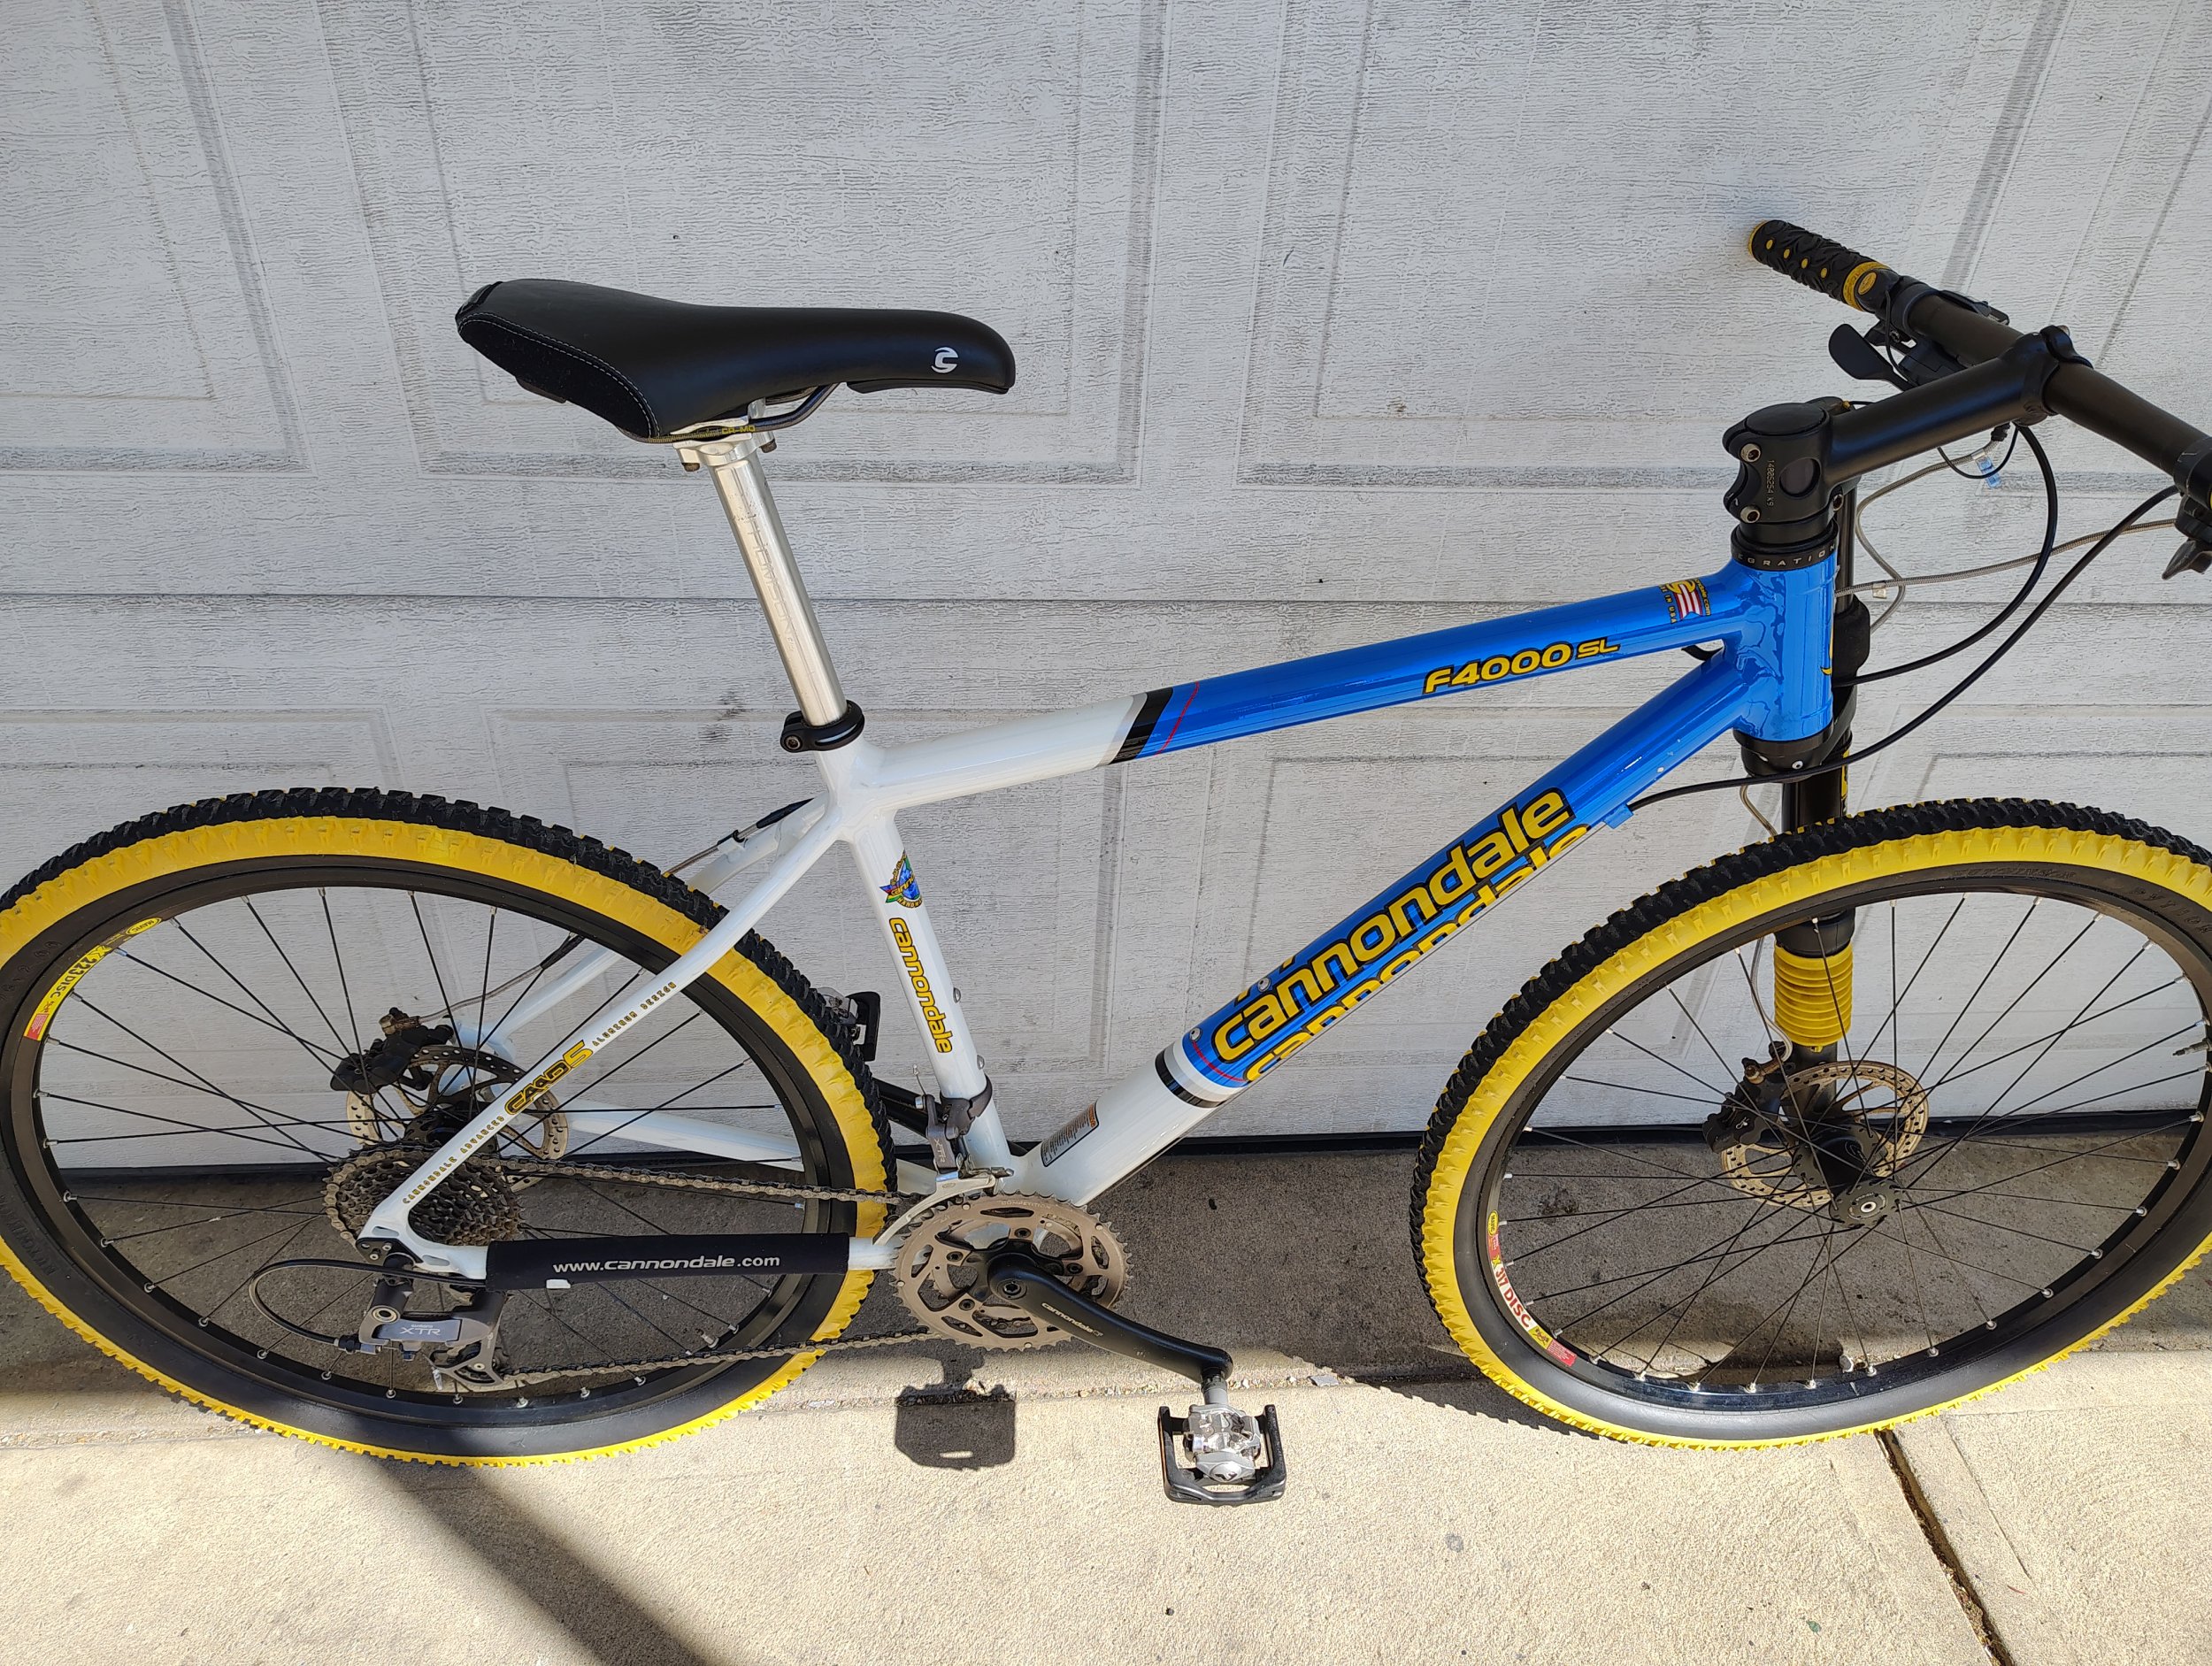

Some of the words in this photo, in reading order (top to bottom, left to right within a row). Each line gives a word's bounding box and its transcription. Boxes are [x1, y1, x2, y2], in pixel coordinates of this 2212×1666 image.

[1423, 641, 1574, 695] F4000
[1575, 636, 1621, 660] SL
[1211, 787, 1577, 1063] cannondale
[50, 976, 77, 999] DISC
[889, 917, 953, 1054] cannondale
[402, 1155, 457, 1204] CANNONDALE
[1041, 1302, 1094, 1333] cannondale
[1495, 1267, 1510, 1287] 317
[1504, 1287, 1532, 1327] DISC
[399, 1327, 442, 1336] XTR
